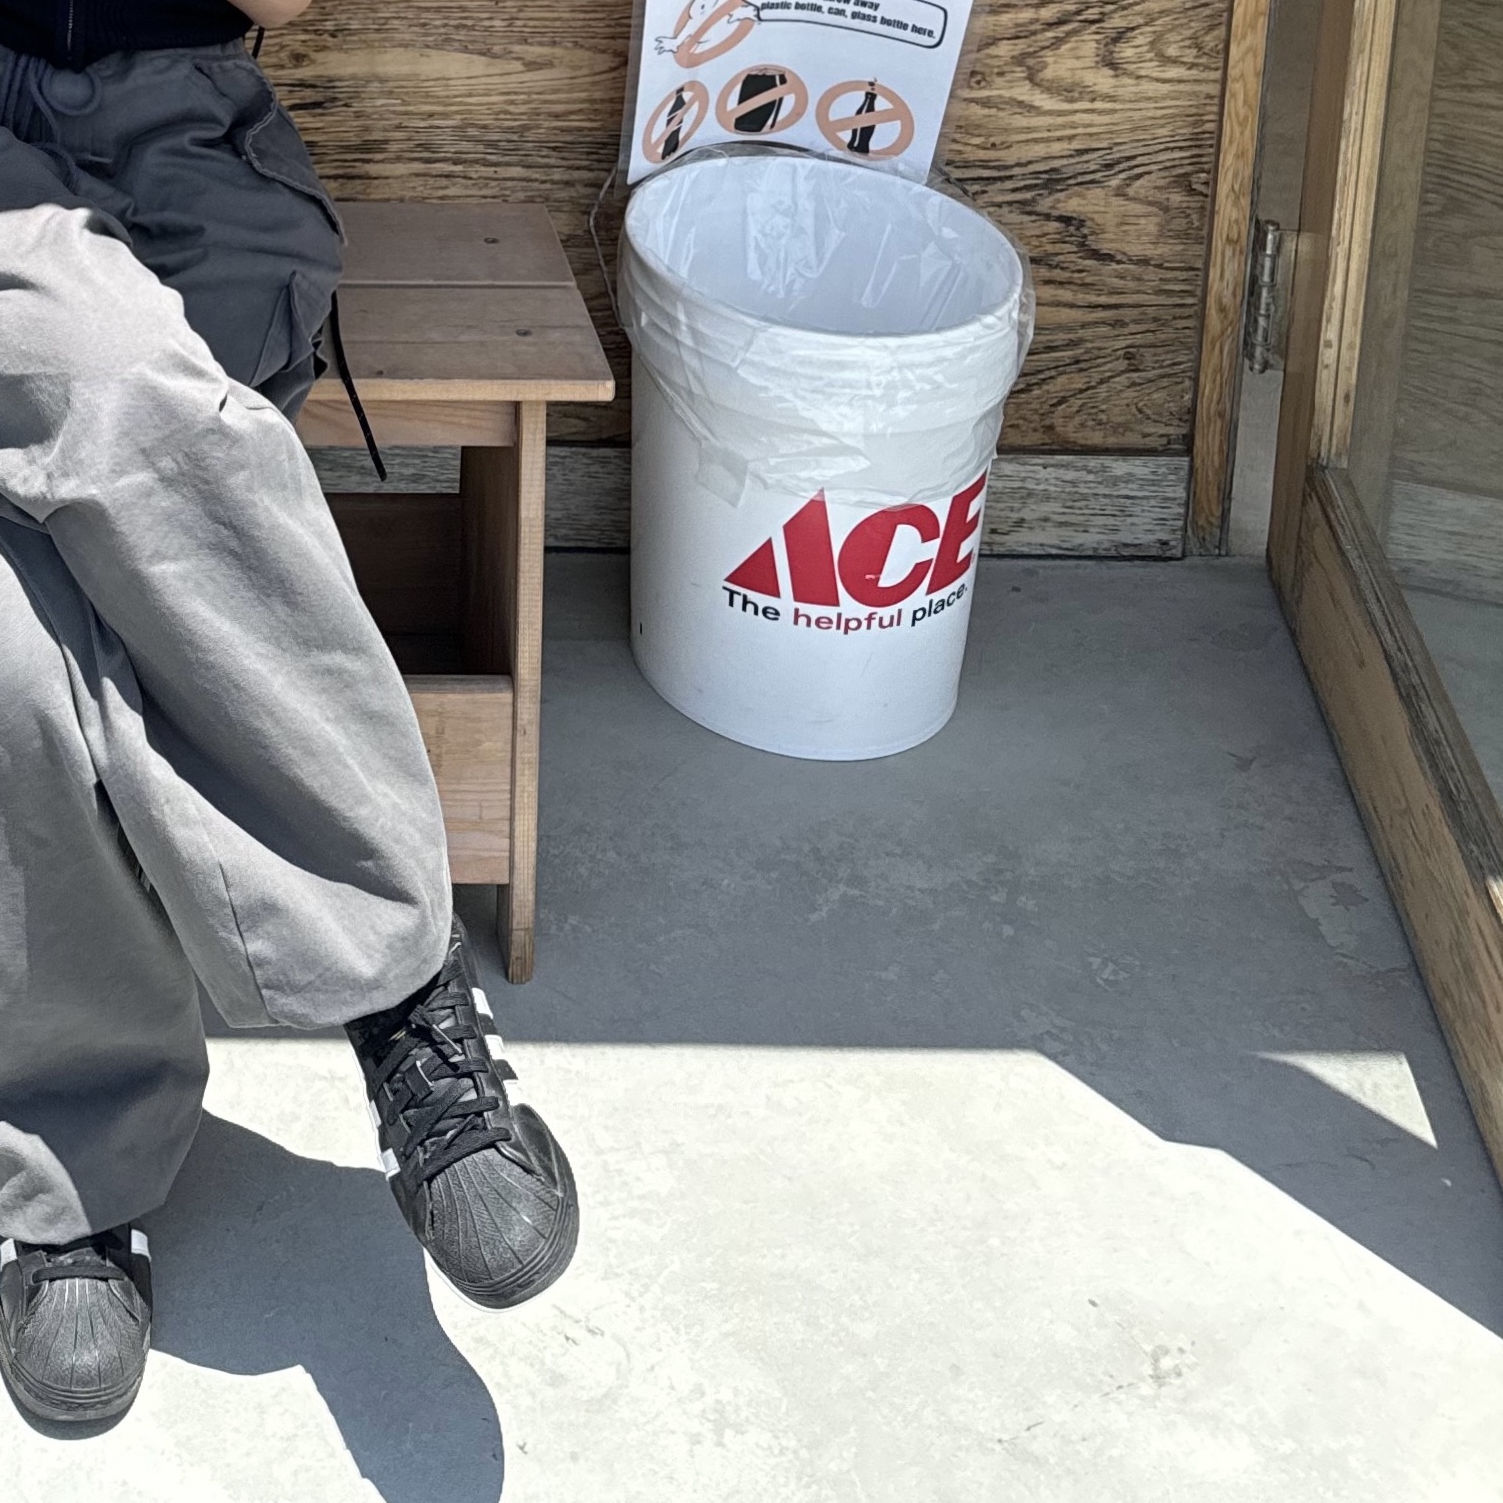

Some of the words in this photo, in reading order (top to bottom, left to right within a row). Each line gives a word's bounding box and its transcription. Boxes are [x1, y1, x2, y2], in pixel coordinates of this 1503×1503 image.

[760, 1, 793, 12] plastic
[851, 11, 878, 24] glass
[879, 16, 910, 32] bottle
[910, 23, 937, 40] here.
[722, 467, 988, 608] ACE
[721, 585, 782, 622] The
[792, 607, 903, 636] helpful
